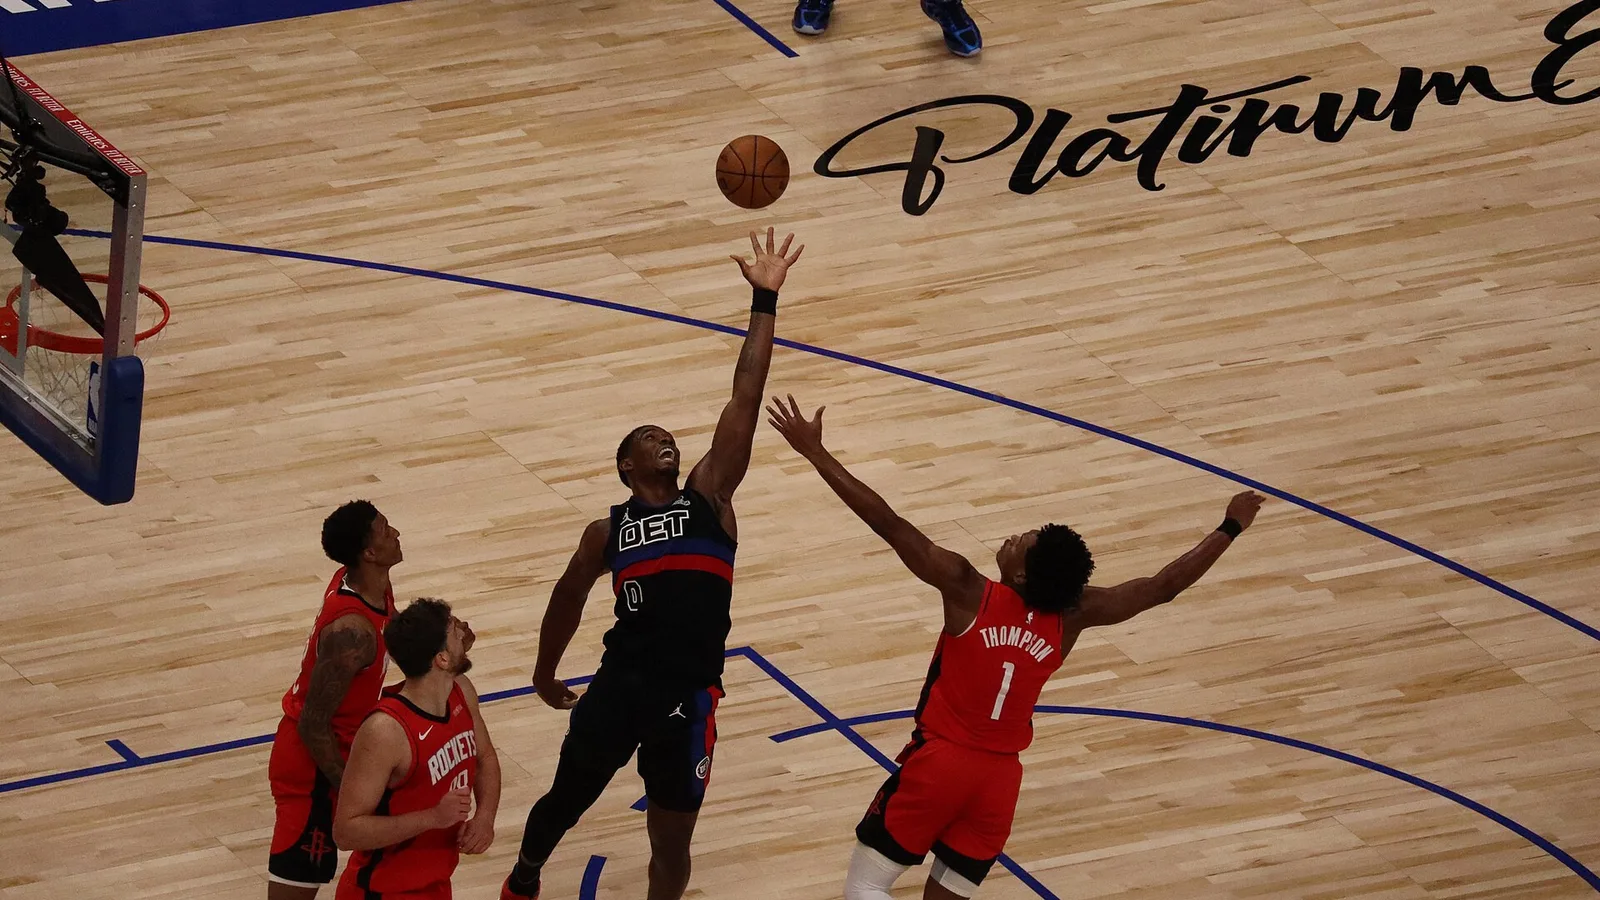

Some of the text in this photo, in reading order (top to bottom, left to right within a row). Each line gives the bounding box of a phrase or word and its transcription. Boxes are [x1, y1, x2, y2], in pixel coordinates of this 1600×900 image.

[66, 119, 109, 149] Emirates
[814, 65, 1533, 216] Platinum
[619, 509, 690, 552] DET
[623, 580, 643, 611] 0
[979, 625, 1055, 663] THOMPSON
[990, 661, 1015, 720] 1
[427, 729, 477, 786] ROCKETS
